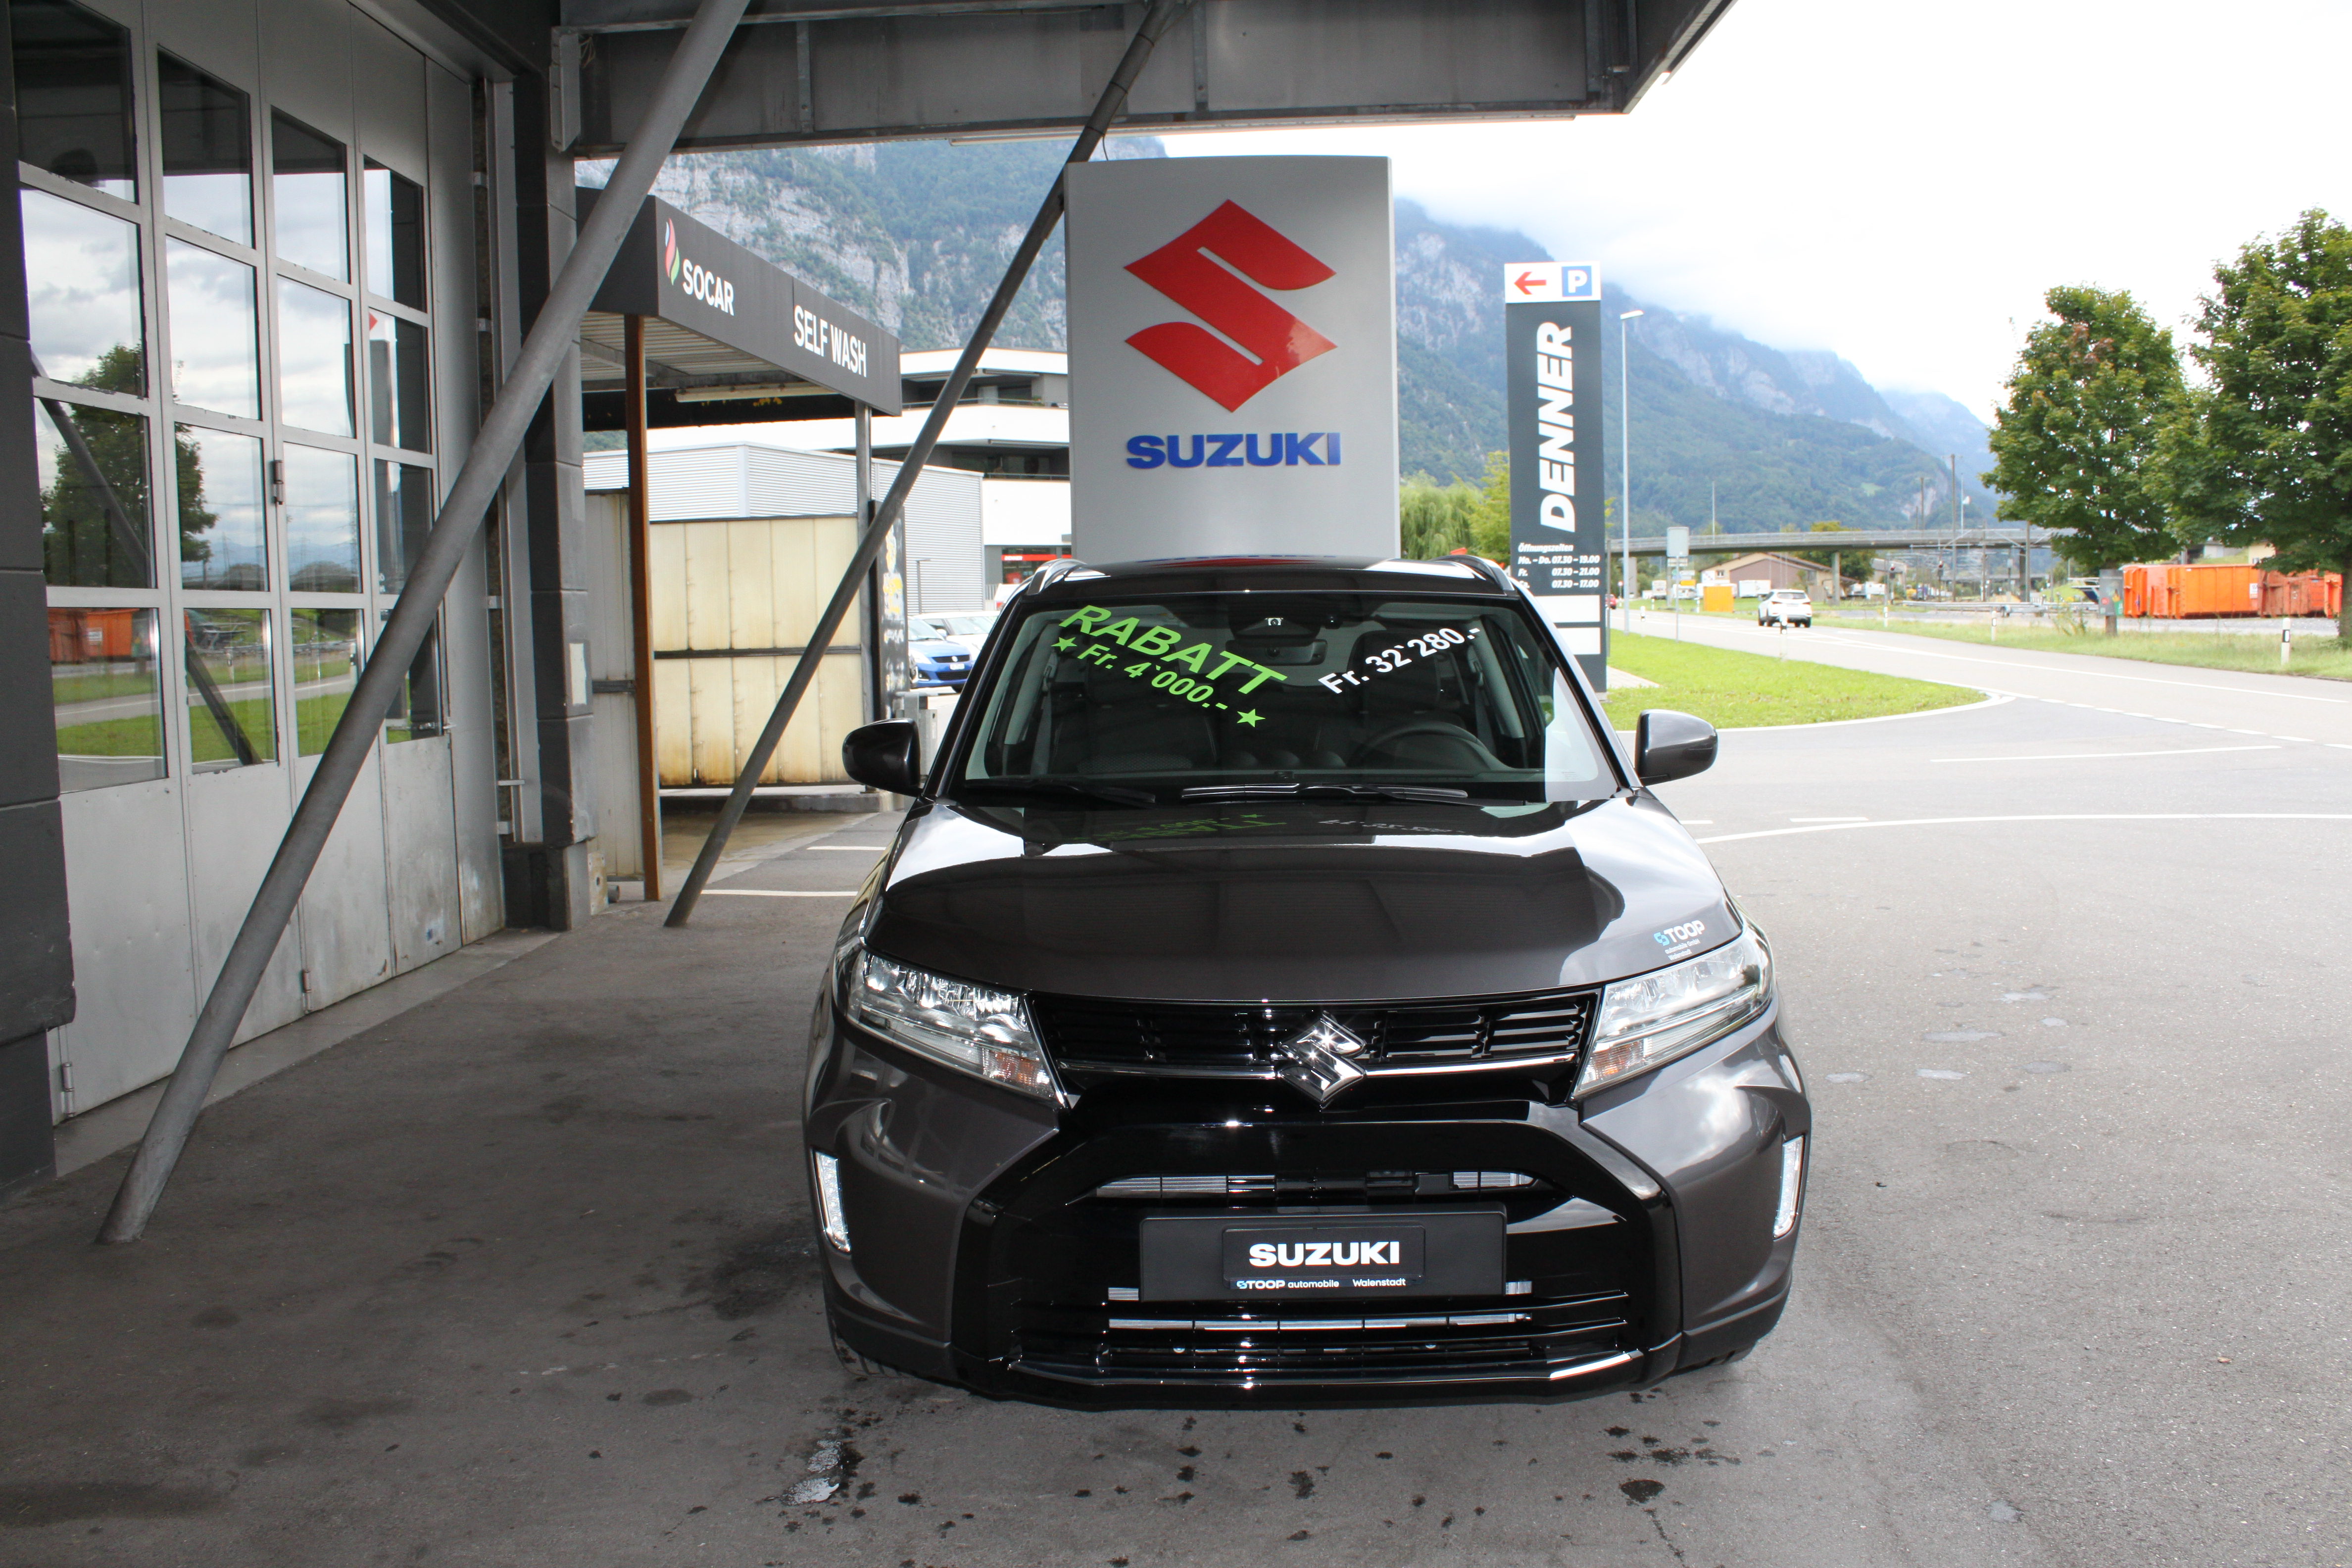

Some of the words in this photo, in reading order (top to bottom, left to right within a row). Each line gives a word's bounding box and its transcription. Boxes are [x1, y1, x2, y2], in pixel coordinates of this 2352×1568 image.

[682, 259, 735, 316] SOCAR
[1567, 269, 1589, 294] P
[794, 305, 829, 357] SELF
[829, 324, 867, 378] WASH
[1536, 322, 1576, 533] DENNER
[1126, 432, 1342, 469] SUZUKI
[1518, 542, 1574, 553] Öffnungszeiten
[1518, 556, 1531, 564] Mo.
[1538, 556, 1551, 564] Do.
[1552, 555, 1573, 564] 07.30
[1579, 555, 1600, 563] 19.00
[1518, 568, 1528, 577] Fr.
[1552, 568, 1573, 576] 07.30
[1579, 567, 1600, 576] 21.00
[1552, 580, 1573, 588] 07.30
[1579, 579, 1599, 588] 17.00
[1058, 605, 1288, 695] RABATT
[1077, 644, 1114, 670] Fr.
[1318, 673, 1370, 694] Fr.
[1248, 1241, 1400, 1268] SUZUKI
[1287, 1279, 1339, 1288] automobile
[1352, 1278, 1407, 1287] Walenstadt
